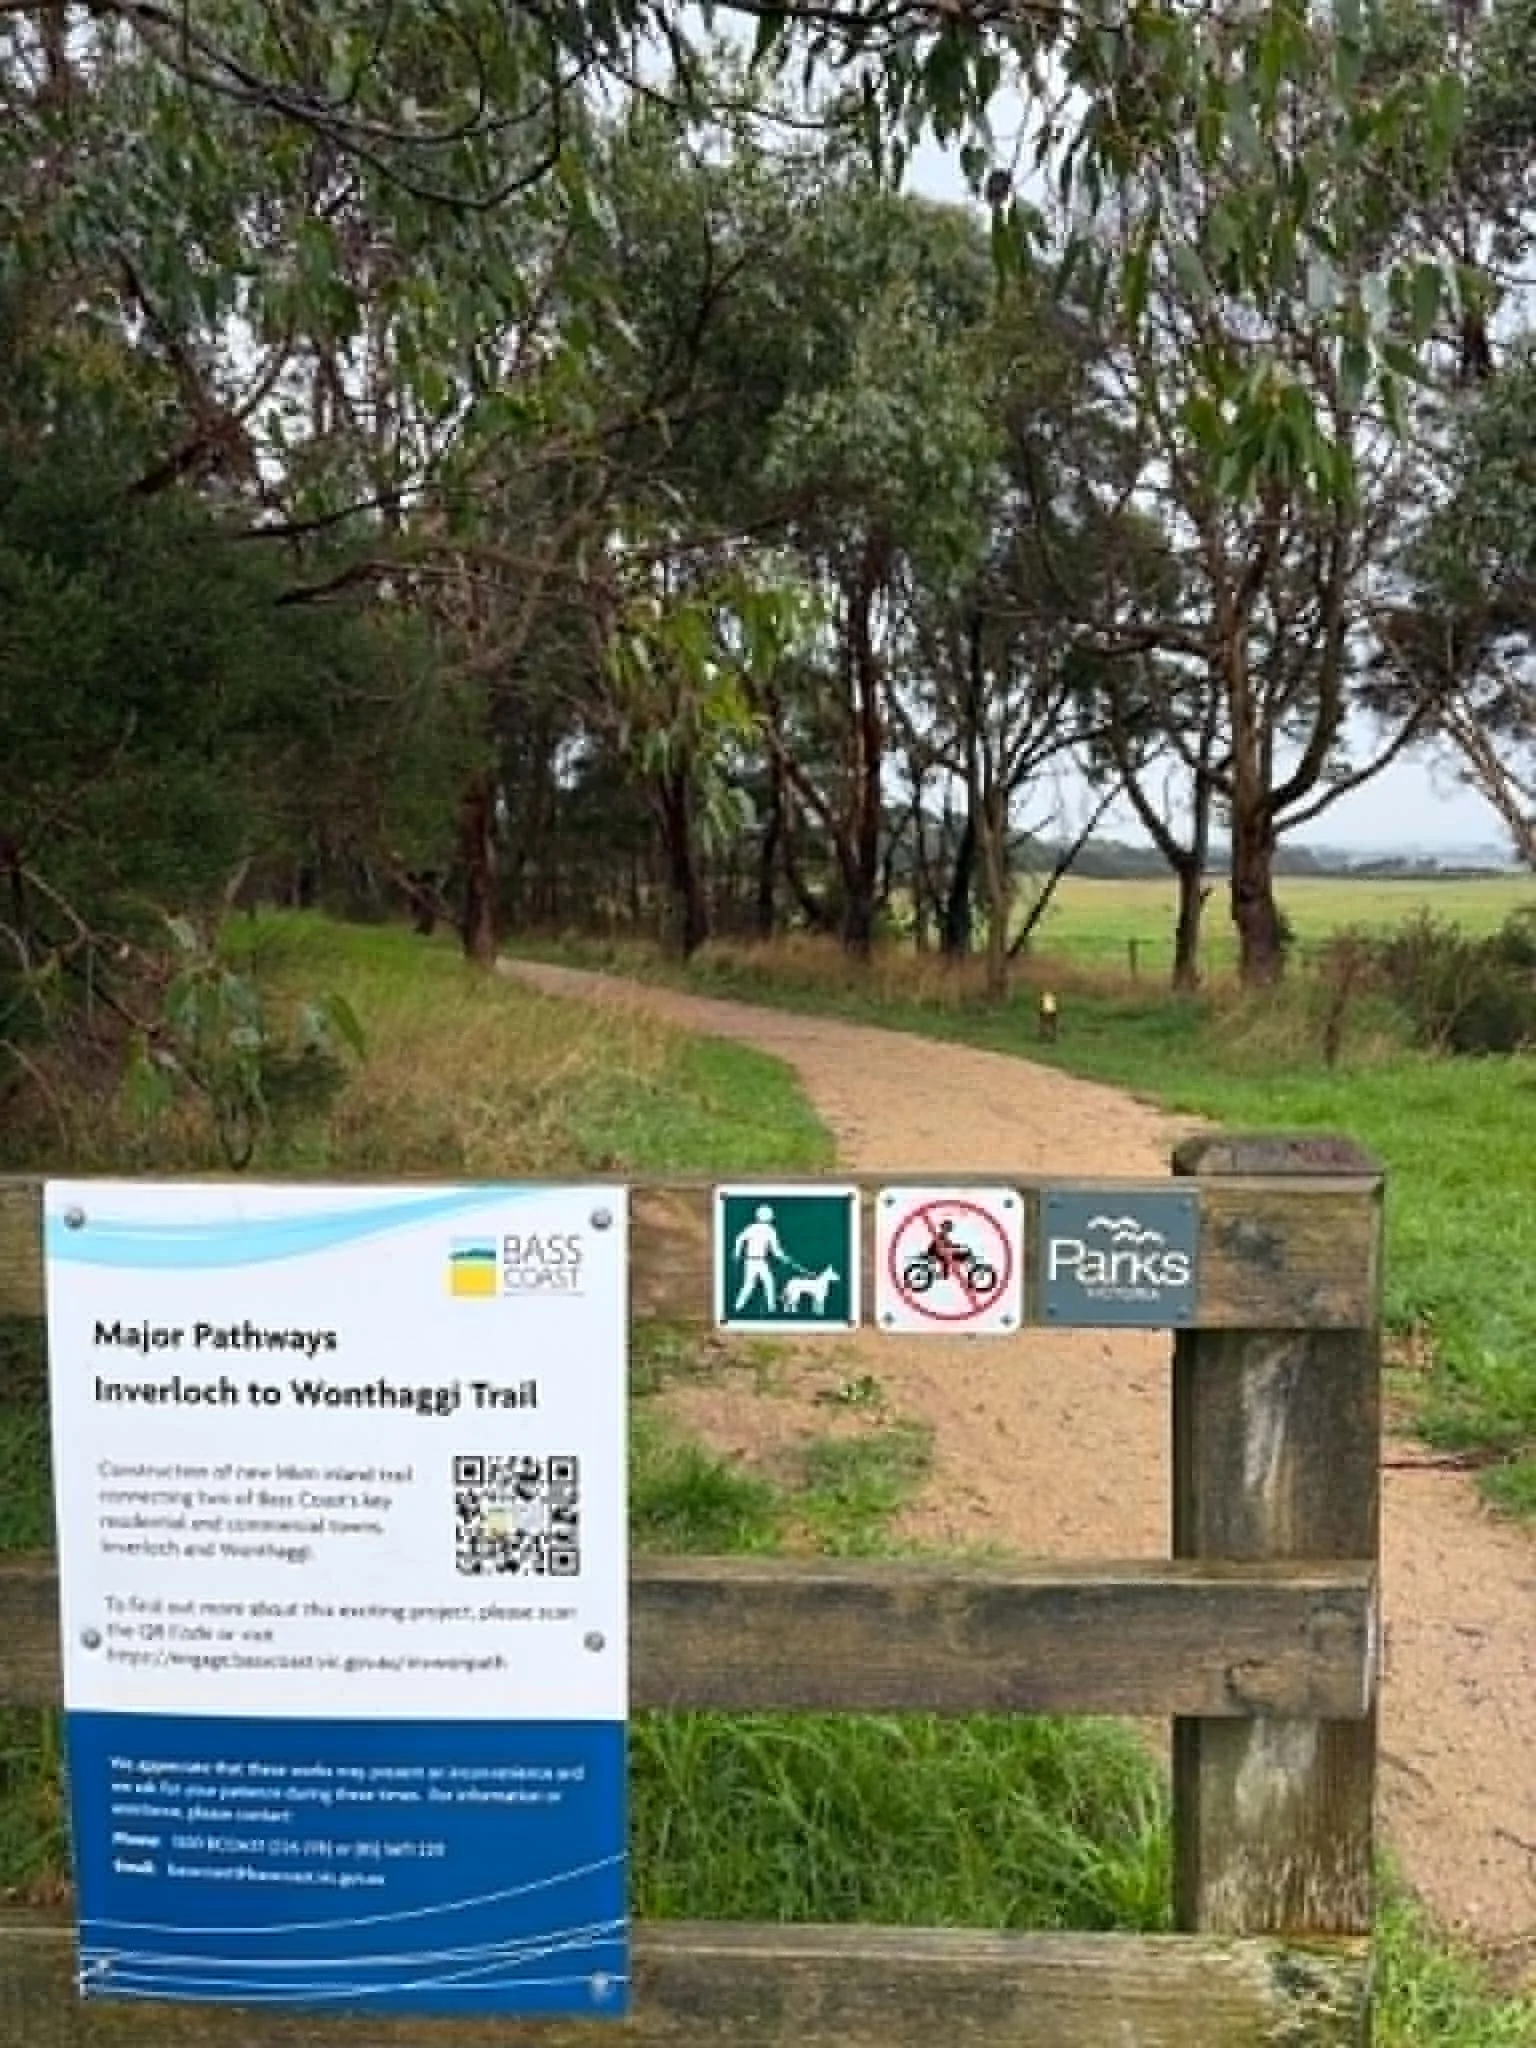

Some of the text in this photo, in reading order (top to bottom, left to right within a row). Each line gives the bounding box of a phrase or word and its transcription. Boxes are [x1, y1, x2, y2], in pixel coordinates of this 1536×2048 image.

[503, 1232, 584, 1265] BASS
[1047, 1237, 1191, 1288] Parks
[503, 1266, 580, 1289] COAST
[95, 1319, 337, 1359] Major Pathways
[95, 1375, 538, 1417] Inverloch to Wonthaggi Trail
[98, 1459, 209, 1479] Construction
[213, 1463, 233, 1479] of
[236, 1466, 271, 1480] new
[379, 1463, 413, 1482] trail
[100, 1489, 193, 1508] connecting
[198, 1489, 231, 1505] two
[234, 1487, 254, 1505] of
[258, 1490, 294, 1507] Bass
[361, 1491, 393, 1511] key
[100, 1511, 185, 1529] residential
[191, 1514, 222, 1531] and
[101, 1536, 179, 1557] Inverloch
[184, 1541, 216, 1558] and
[104, 1595, 125, 1613] To
[167, 1601, 193, 1616] out
[200, 1602, 244, 1616] more
[249, 1600, 297, 1617] about
[339, 1604, 404, 1623] exciting
[479, 1601, 532, 1622] please
[105, 1623, 133, 1638] the
[217, 1628, 234, 1641] or
